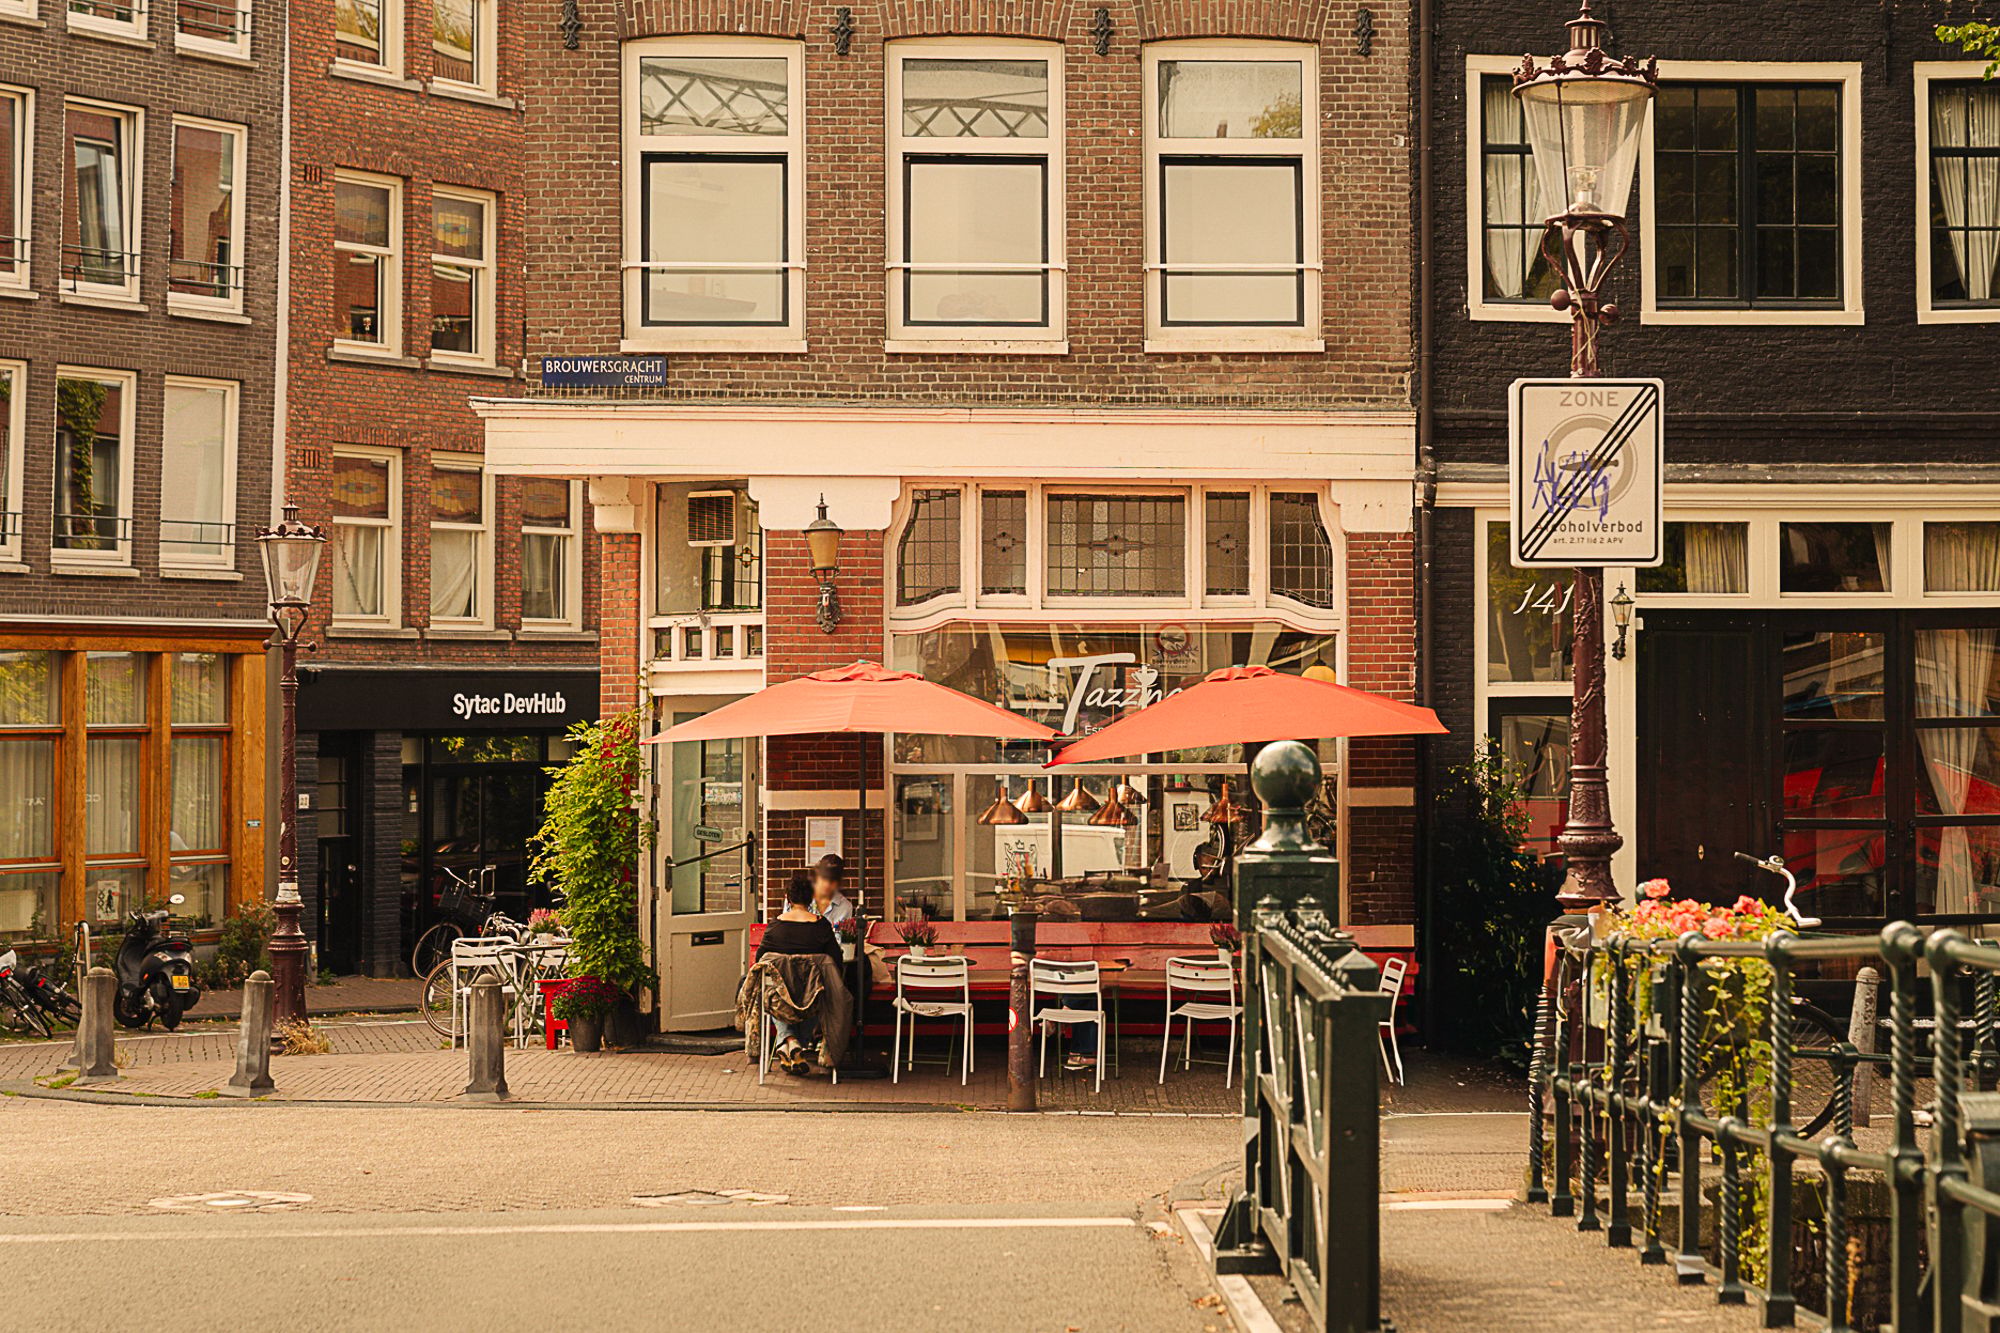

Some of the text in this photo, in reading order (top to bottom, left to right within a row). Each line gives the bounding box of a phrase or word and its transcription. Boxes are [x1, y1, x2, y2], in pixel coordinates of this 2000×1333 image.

[545, 360, 663, 373] BROUWERSGRACHT
[624, 375, 663, 384] CENTRUM
[1559, 391, 1619, 407] ZONE
[1536, 520, 1643, 533] oholverbod
[1553, 536, 1624, 544] art. 2.17 lid 2 APV
[1513, 583, 1576, 615] 141
[453, 691, 566, 720] Sytac DevHub
